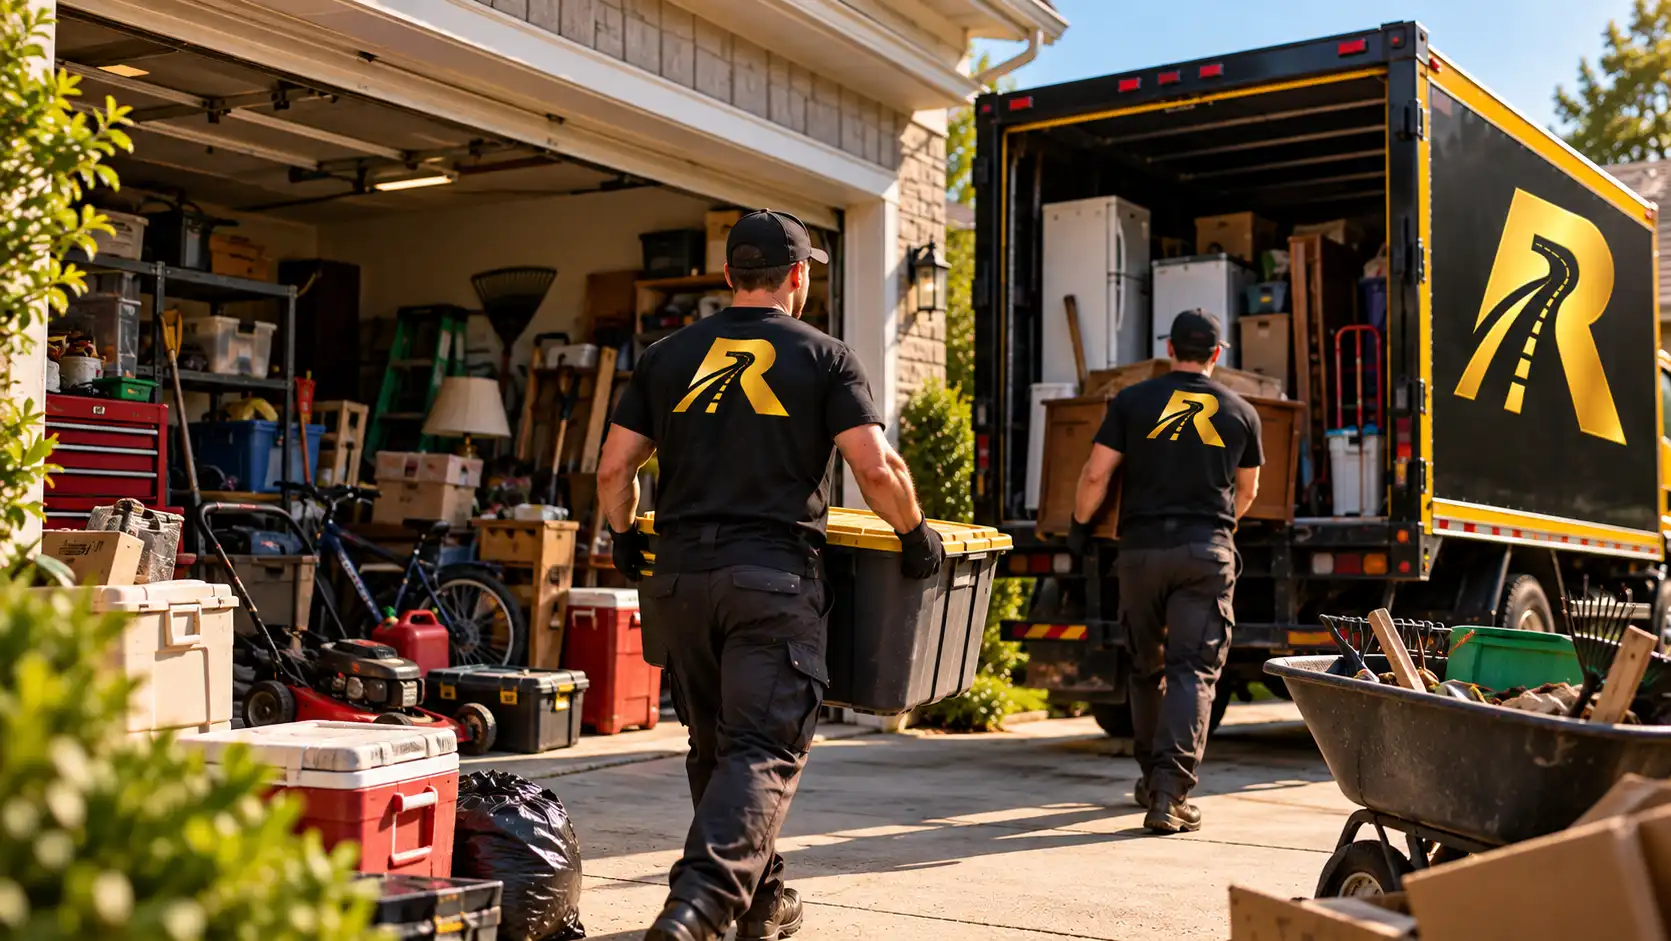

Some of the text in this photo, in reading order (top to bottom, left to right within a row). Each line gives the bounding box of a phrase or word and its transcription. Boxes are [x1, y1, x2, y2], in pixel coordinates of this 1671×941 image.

[1454, 188, 1627, 446] R
[673, 337, 790, 417] R
[1147, 390, 1226, 448] R
